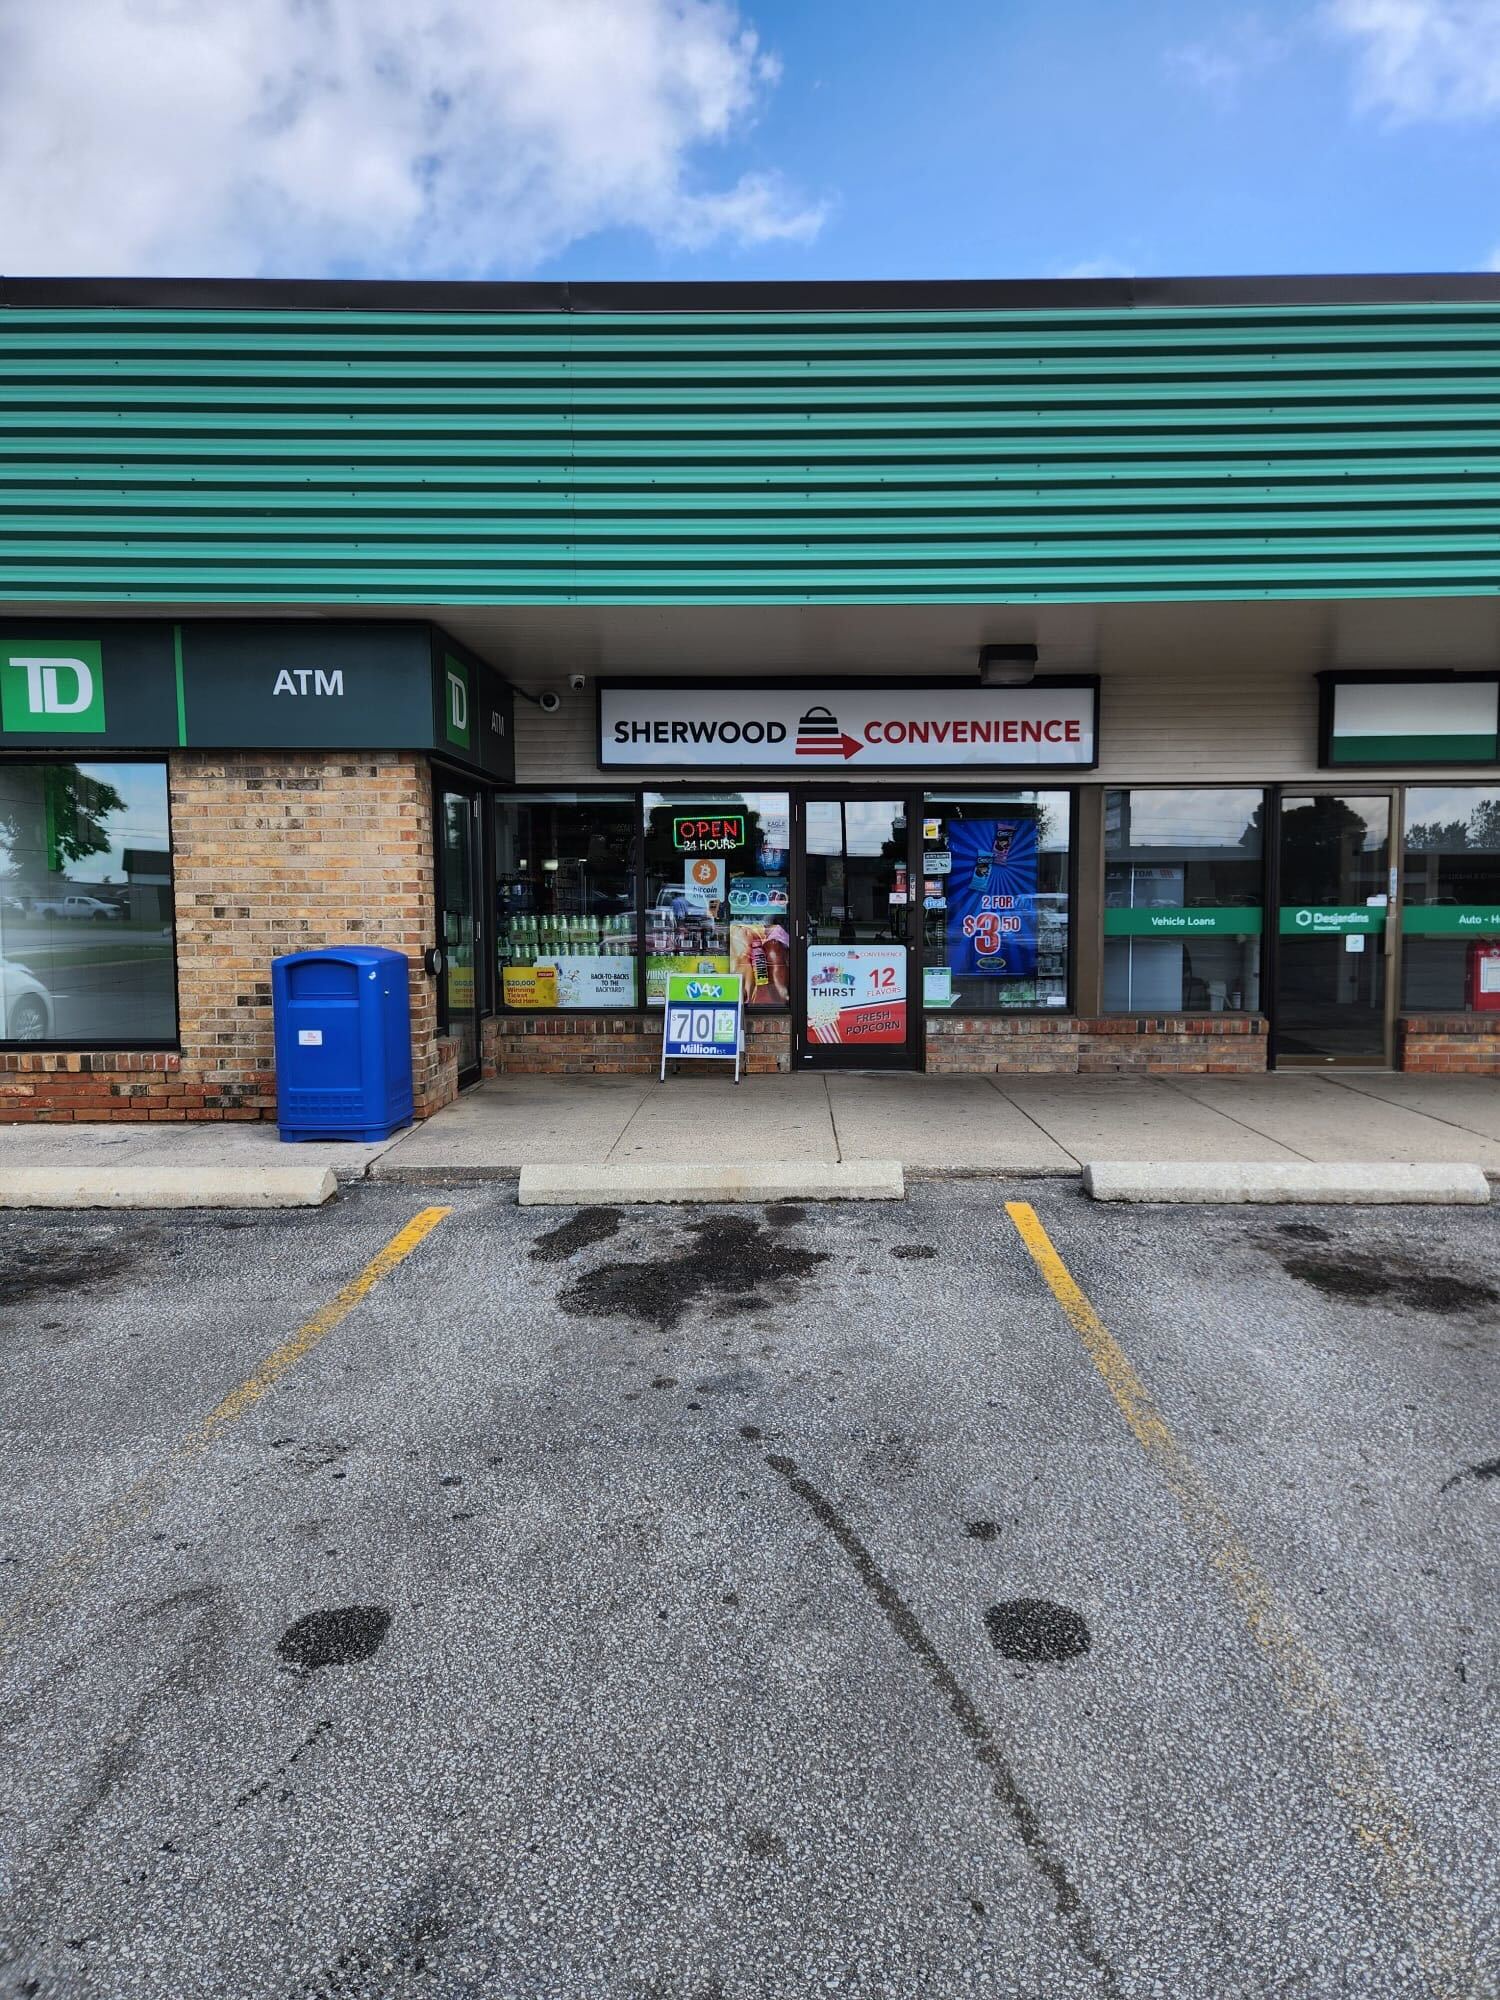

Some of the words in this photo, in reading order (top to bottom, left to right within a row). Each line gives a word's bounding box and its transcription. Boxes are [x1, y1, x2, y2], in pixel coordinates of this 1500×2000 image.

[9, 657, 93, 714] TD
[272, 669, 344, 696] ATM
[448, 671, 467, 730] TD
[491, 711, 505, 737] ATM
[614, 720, 787, 744] SHERWOOD
[864, 720, 1081, 744] CONVENIENCE
[680, 820, 737, 838] OPEN
[683, 840, 697, 851] 24
[699, 839, 737, 850] HOURS
[982, 895, 991, 909] 2
[992, 895, 1014, 909] FOR
[1152, 917, 1185, 926] Vehicle
[1188, 917, 1216, 926] Loans
[1313, 912, 1369, 925] Desjardins
[1459, 914, 1482, 924] Auto
[869, 967, 896, 989] 12
[686, 982, 723, 998] MAX
[811, 988, 856, 997] THIRST
[867, 987, 902, 997] FLAVORS
[857, 1010, 890, 1022] FRESH
[846, 1020, 900, 1035] POPCORN
[680, 1044, 716, 1054] Million
